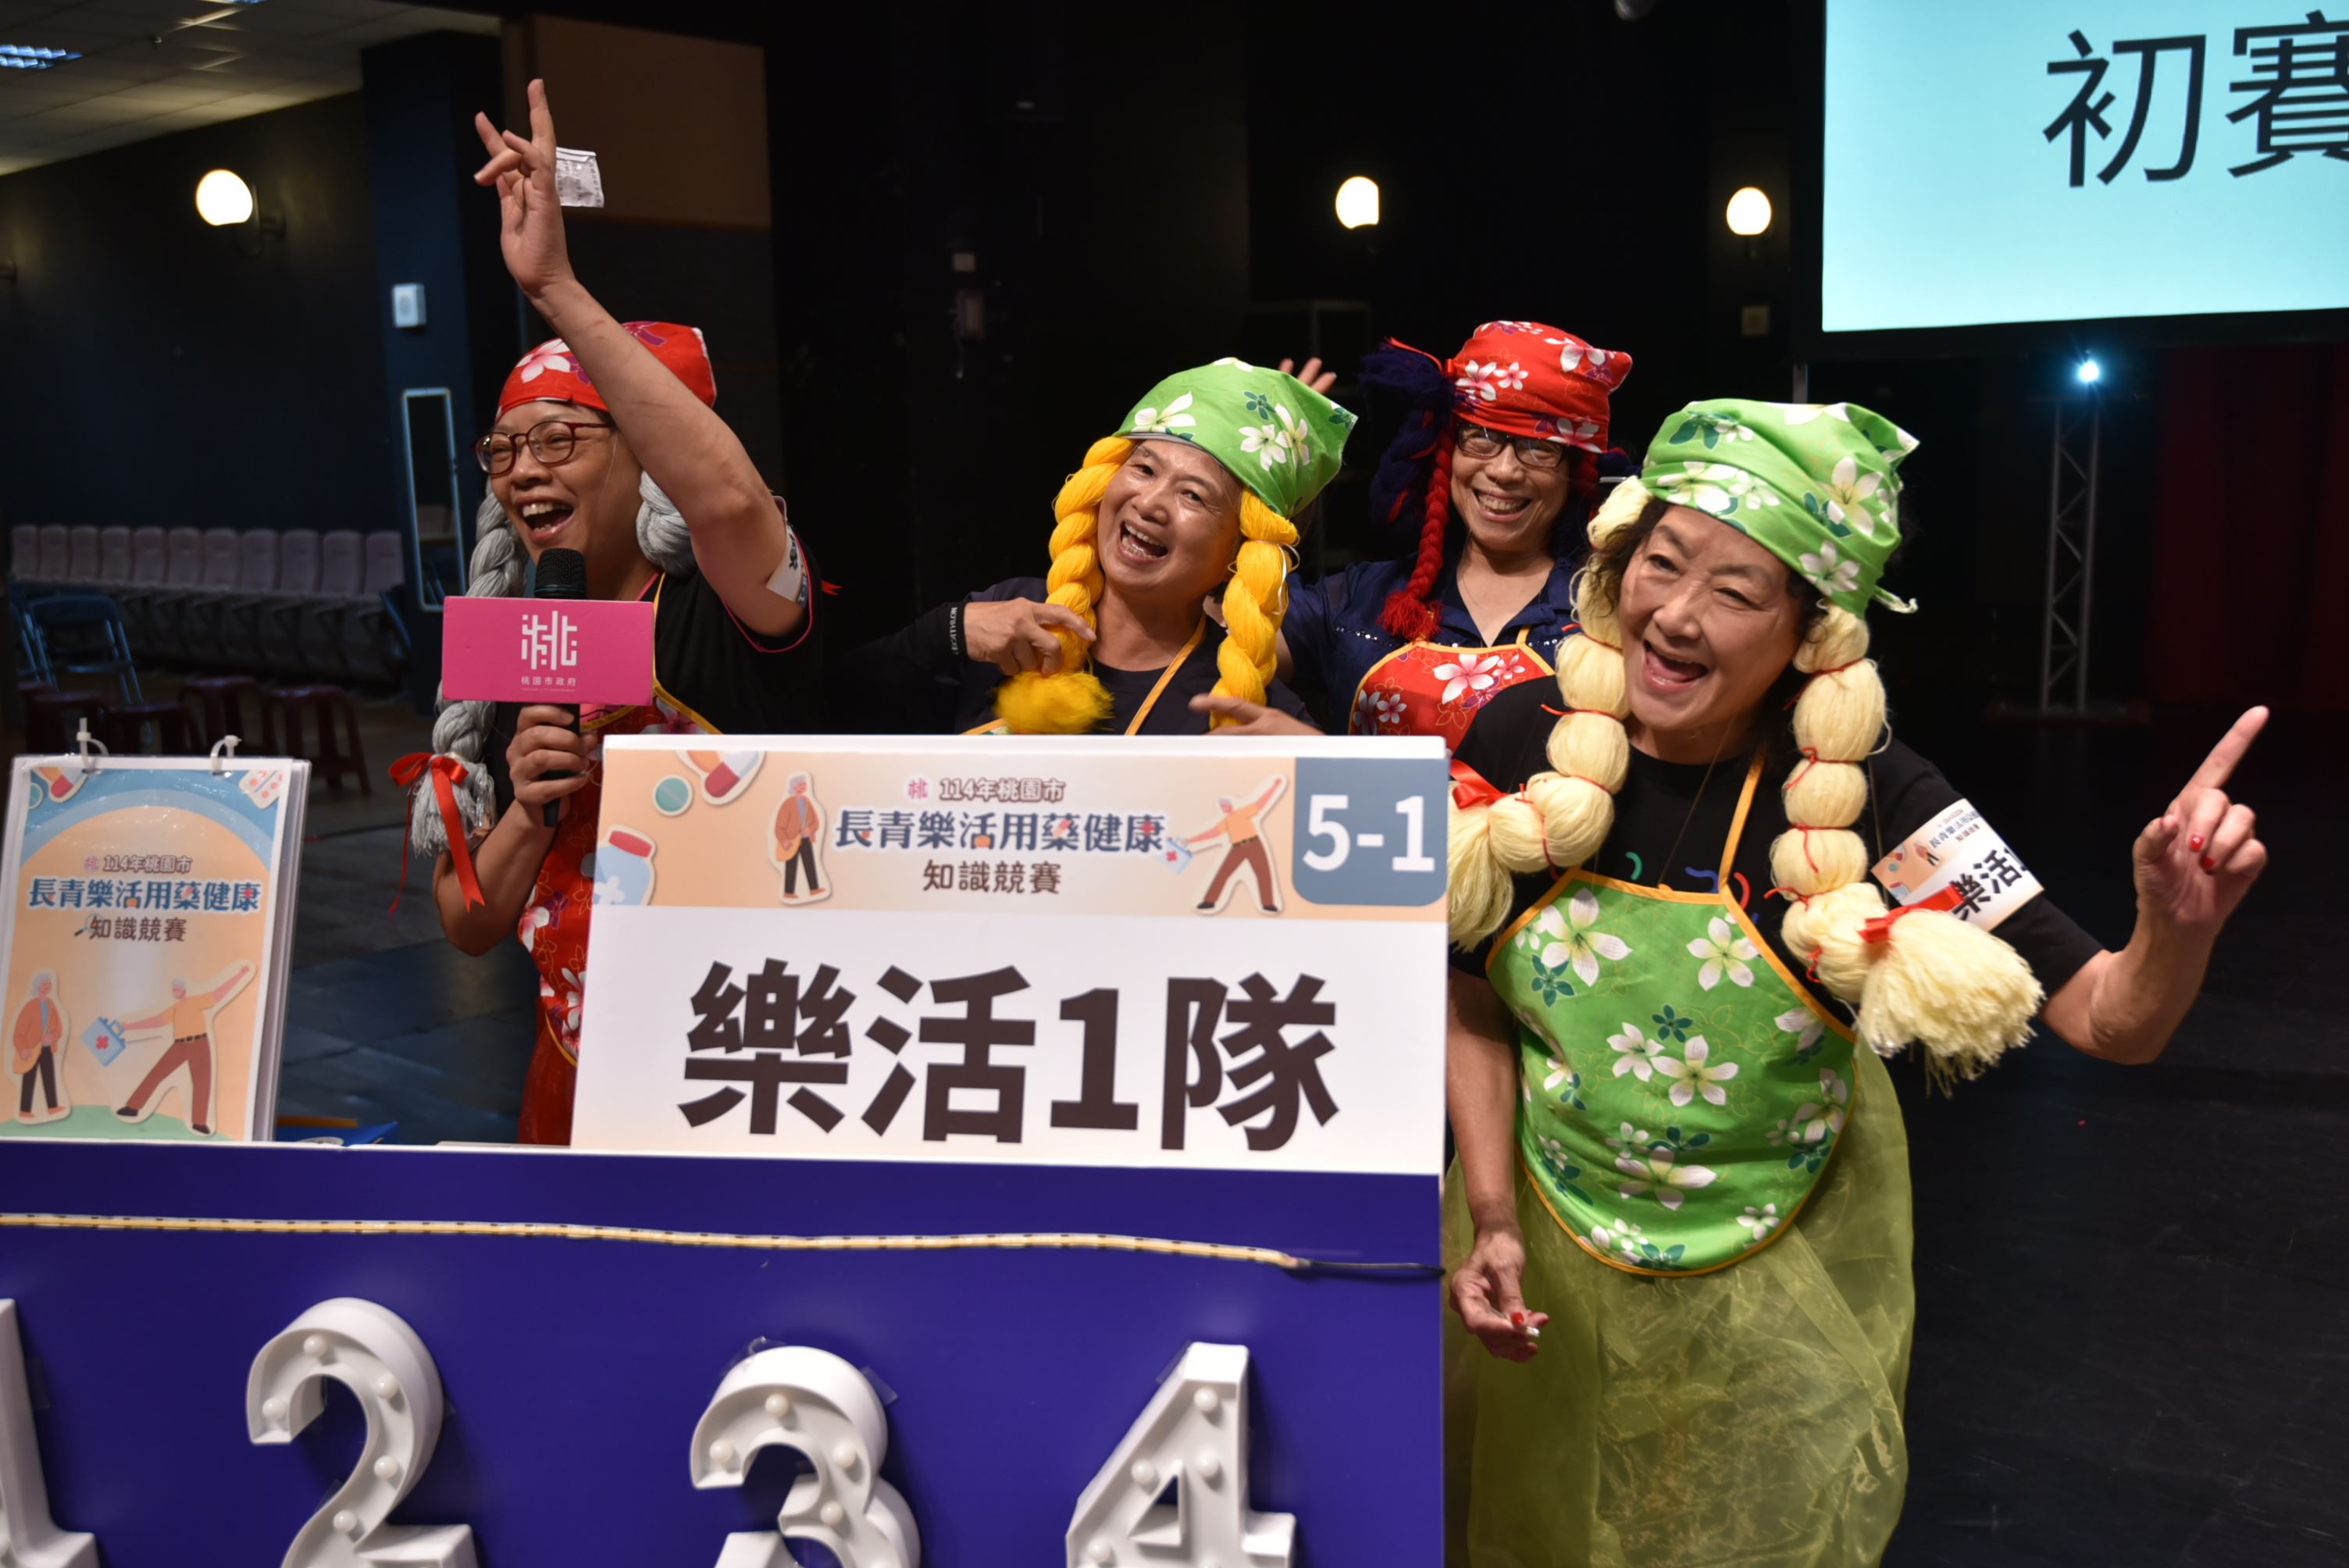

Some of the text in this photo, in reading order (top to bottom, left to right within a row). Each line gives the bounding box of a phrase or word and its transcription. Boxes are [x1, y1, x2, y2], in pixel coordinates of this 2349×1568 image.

[2043, 9, 2349, 187] 初賽
[939, 778, 1066, 803] 114年桃園市
[836, 809, 1166, 853] 長青樂活用藥健康
[1302, 794, 1435, 872] 5-1
[103, 855, 193, 874] 114年桃園市
[923, 860, 1062, 894] 知識競賽
[29, 878, 262, 911] 長青樂活用藥健康
[89, 917, 187, 942] 知識競賽
[677, 957, 1340, 1152] 樂活1隊
